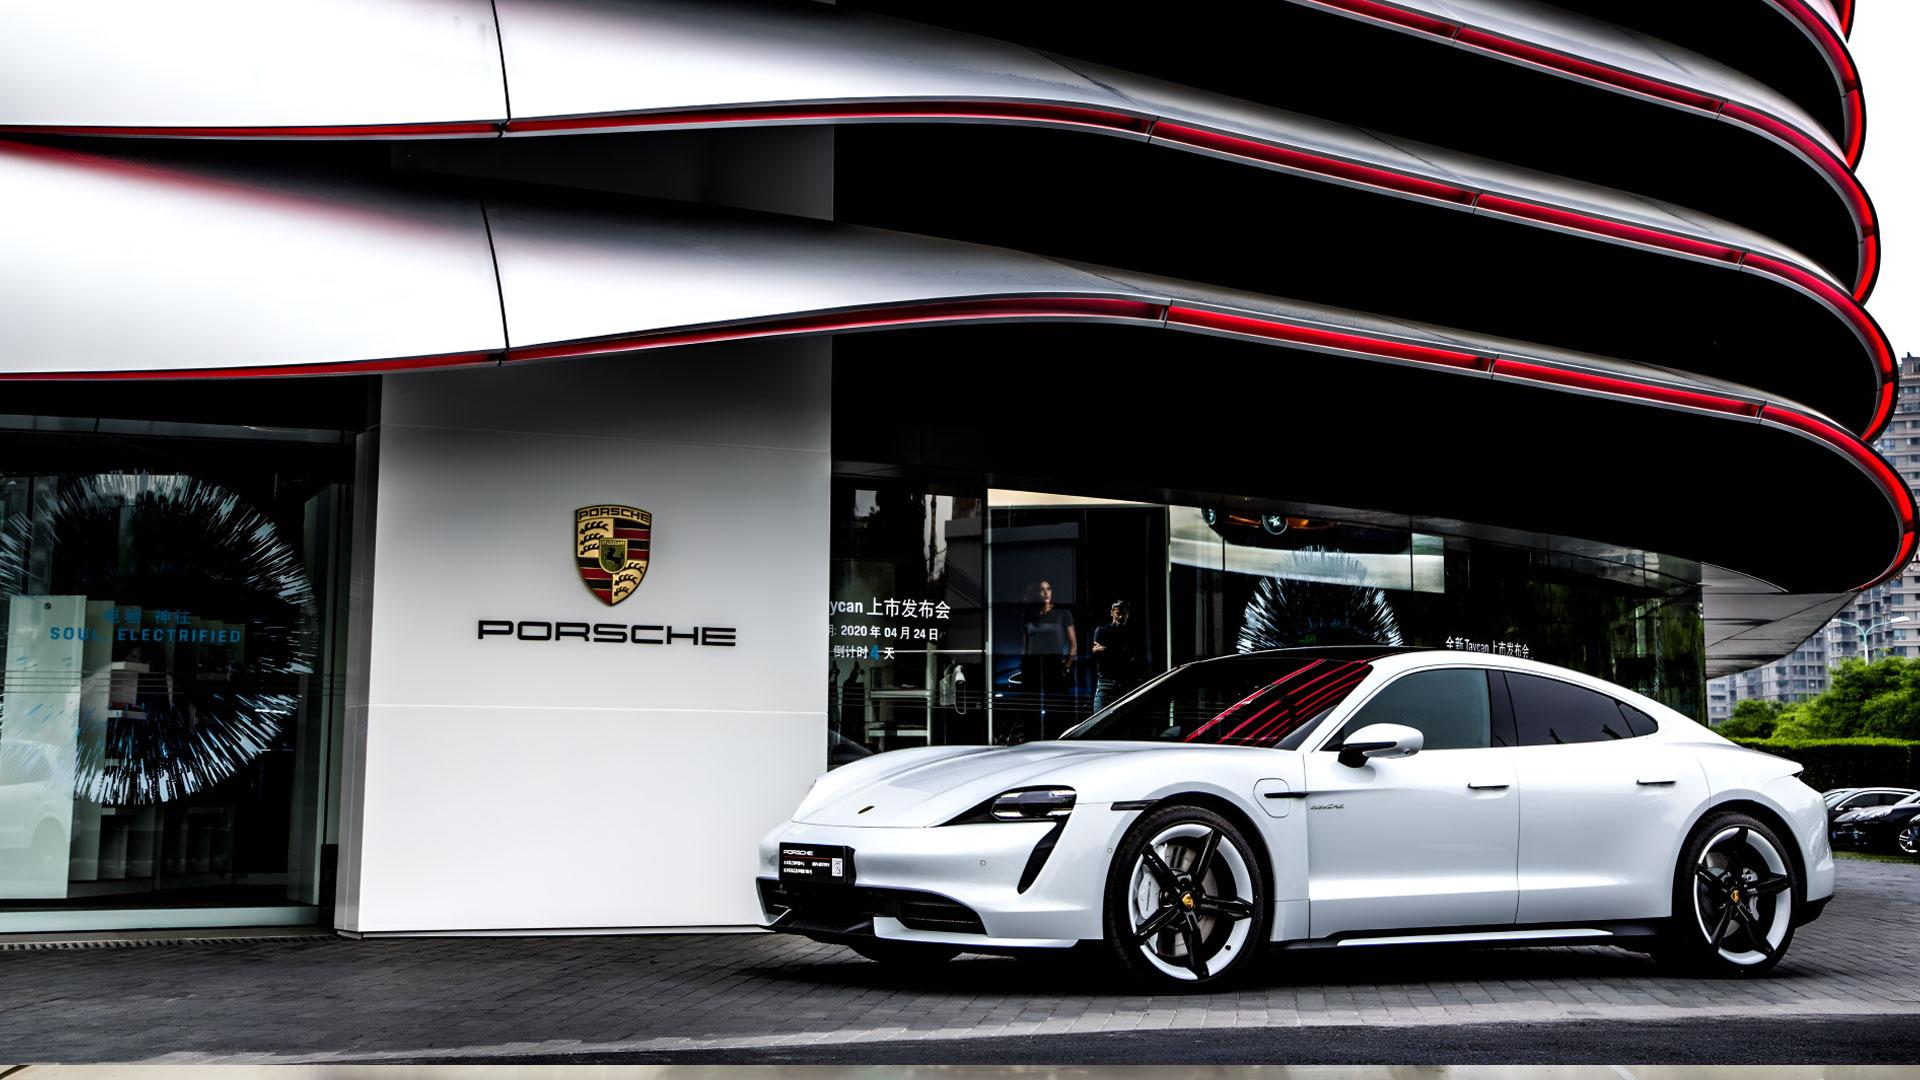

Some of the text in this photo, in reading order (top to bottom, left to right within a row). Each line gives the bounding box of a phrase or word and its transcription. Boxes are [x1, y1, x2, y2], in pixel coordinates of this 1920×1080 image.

[579, 507, 650, 523] PORSCHE
[867, 597, 951, 619] 上市发布会
[117, 628, 241, 643] ELECTRIFIED
[478, 620, 736, 646] PORSCHE
[841, 625, 868, 637] 2020
[869, 625, 881, 638] 年
[884, 627, 897, 638] 04
[900, 626, 910, 640] 月
[913, 628, 926, 639] 24
[929, 628, 938, 641] 日
[1446, 636, 1464, 650] 全新
[833, 645, 868, 659] 倒计时
[884, 647, 895, 660] 天
